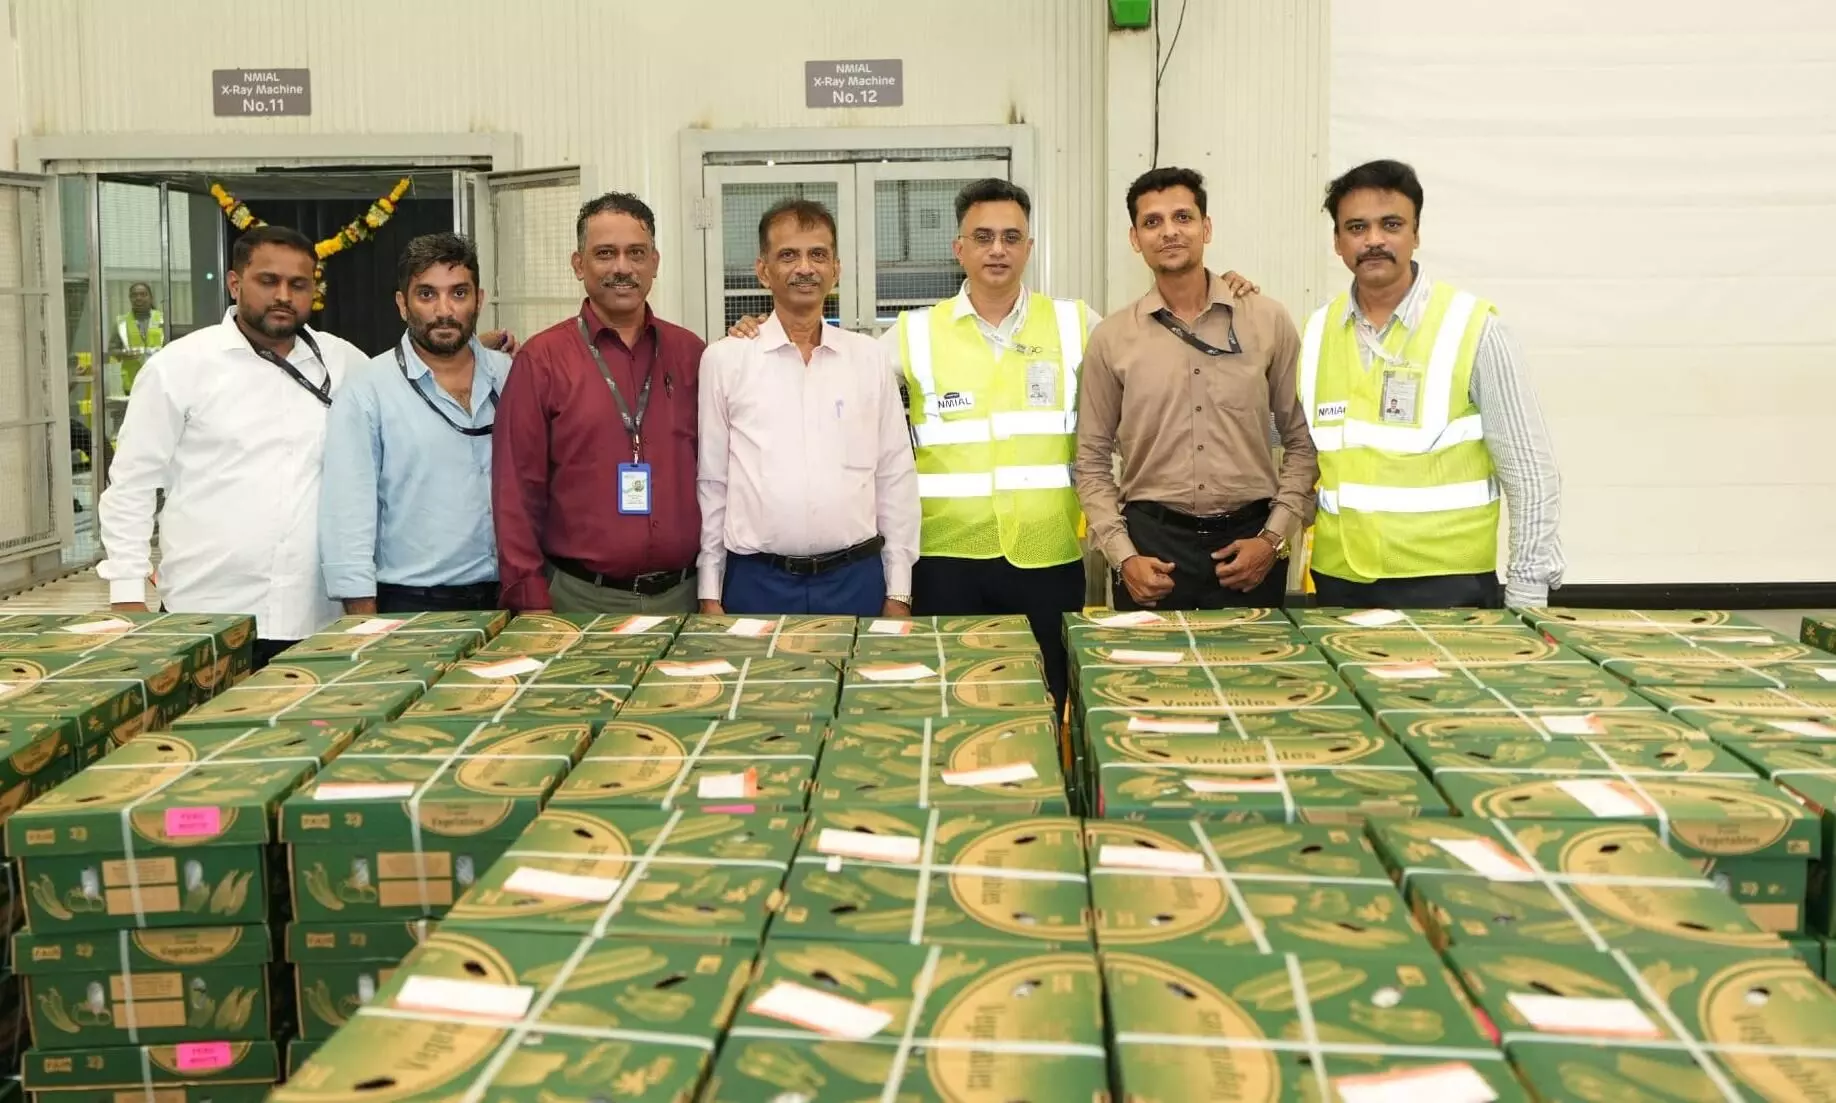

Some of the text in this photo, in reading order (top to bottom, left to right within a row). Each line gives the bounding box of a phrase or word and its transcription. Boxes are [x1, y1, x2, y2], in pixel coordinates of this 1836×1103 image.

[836, 63, 872, 74] NMIAL
[243, 72, 280, 82] NMIAL
[813, 75, 896, 88] X-Ray Machine
[221, 84, 303, 96] X-Ray Machine
[938, 398, 972, 409] NMIAL
